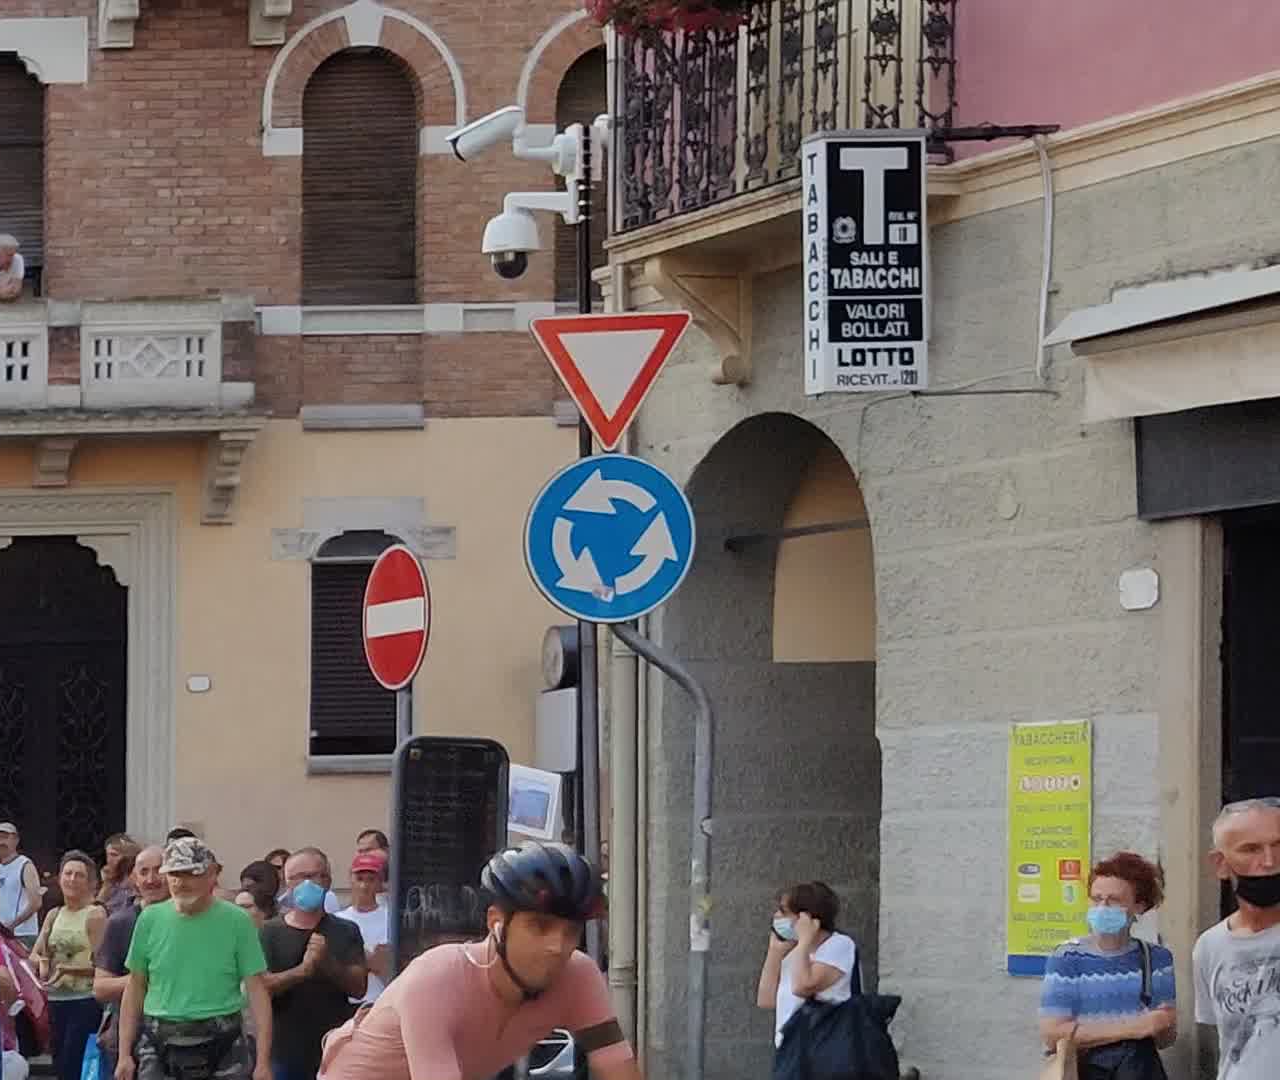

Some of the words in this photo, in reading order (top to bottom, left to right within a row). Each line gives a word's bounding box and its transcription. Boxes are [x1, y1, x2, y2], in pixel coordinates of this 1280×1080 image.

[839, 147, 908, 245] T
[807, 153, 821, 380] TABACCHI
[850, 251, 884, 266] SALI
[888, 250, 899, 265] E
[830, 267, 920, 290] TABACCHI
[845, 304, 905, 320] VALORI
[841, 321, 910, 338] BOLLATI
[837, 347, 915, 368] LOTTO
